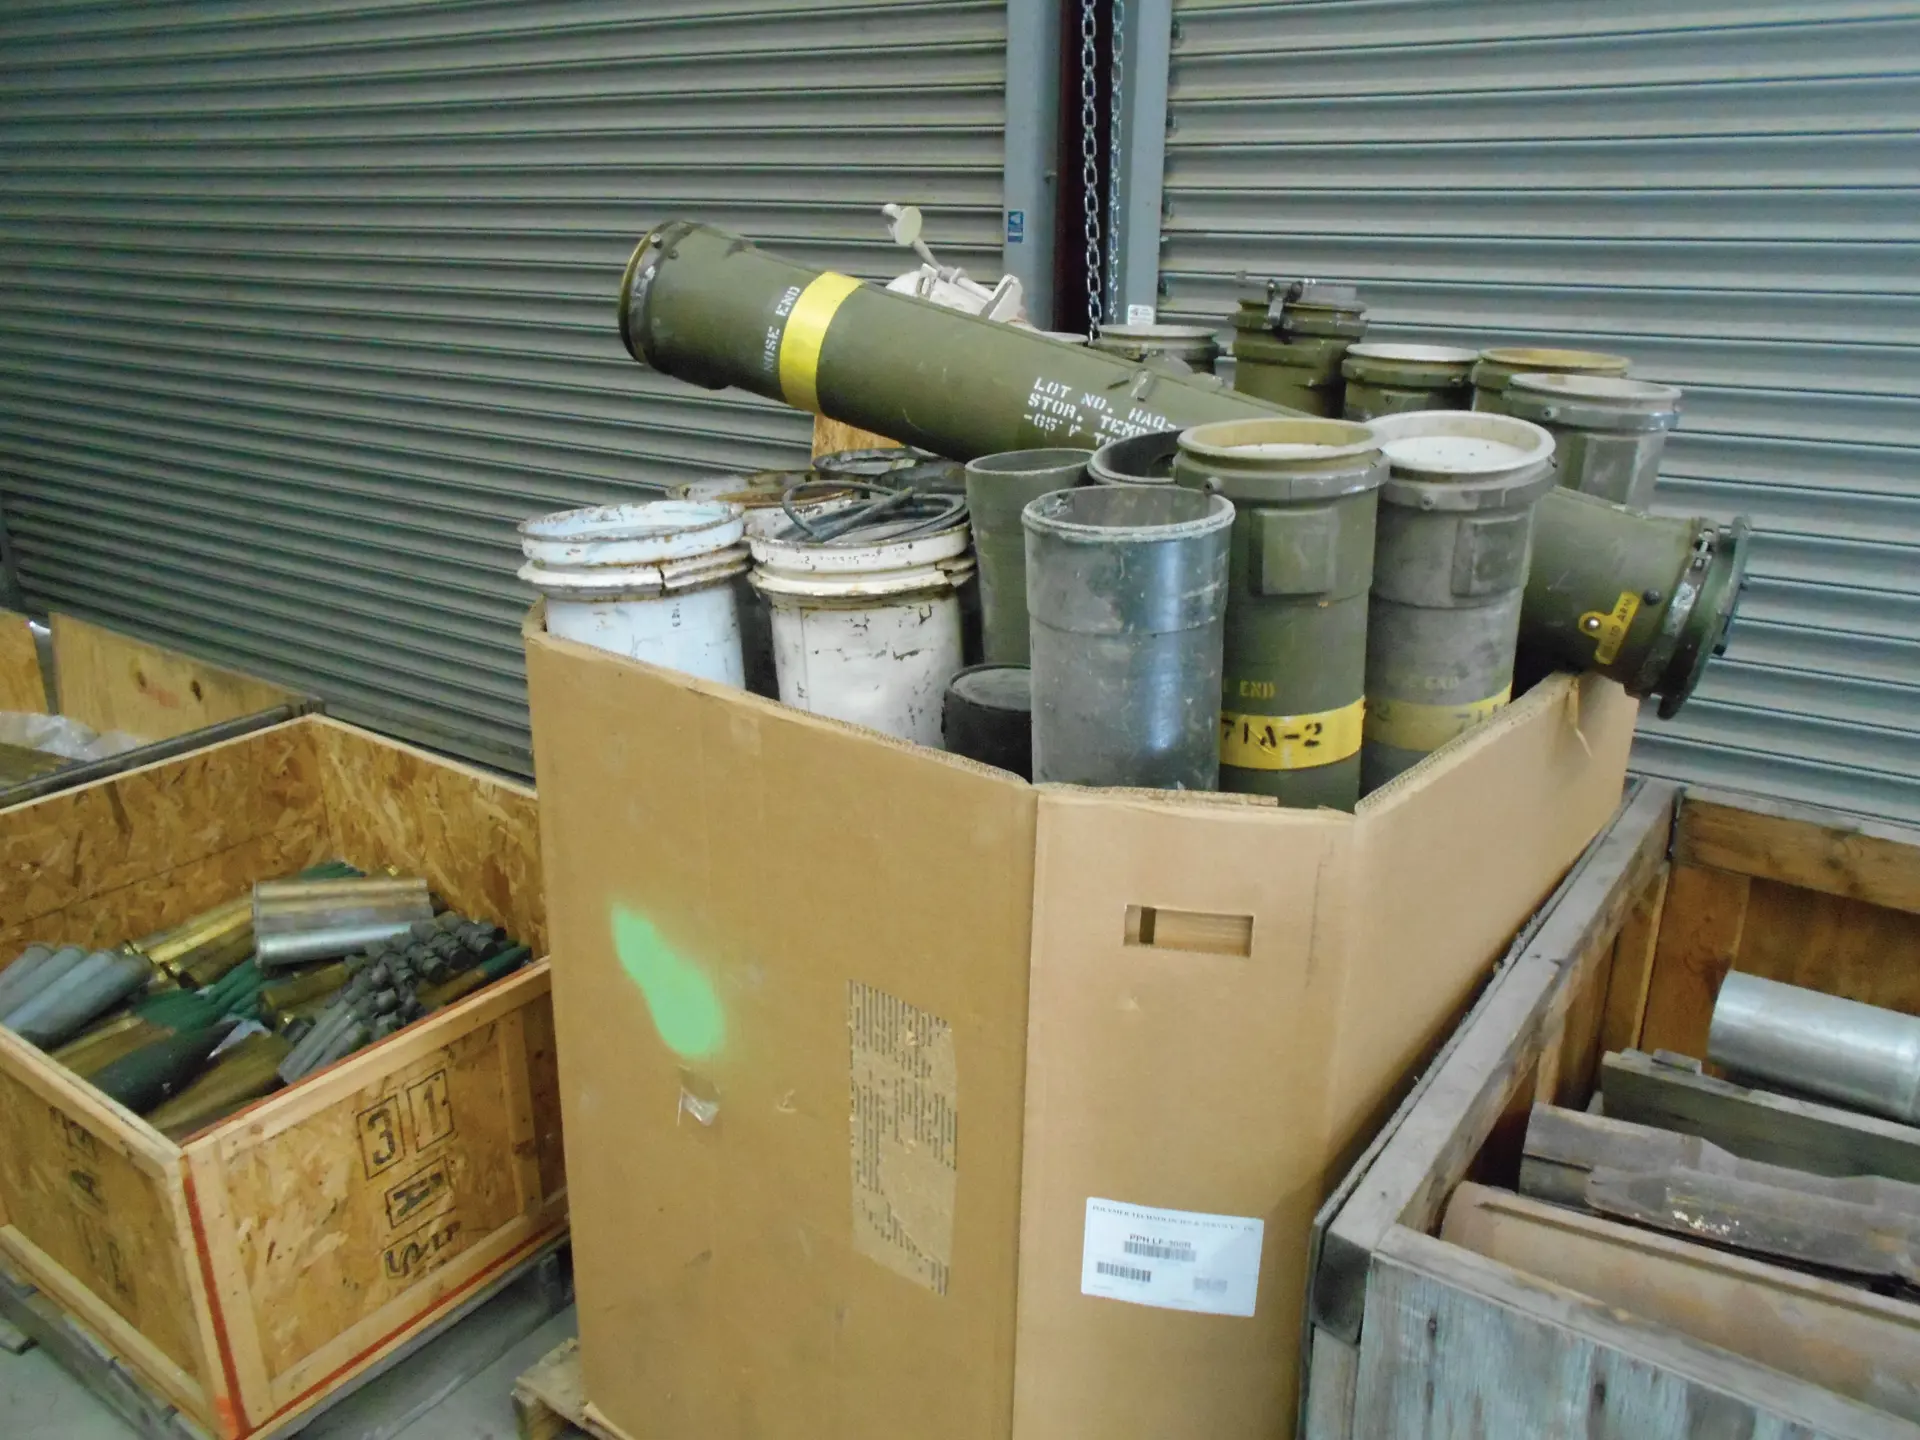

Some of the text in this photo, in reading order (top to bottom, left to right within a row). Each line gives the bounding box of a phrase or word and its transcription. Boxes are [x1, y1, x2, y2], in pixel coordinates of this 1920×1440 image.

[775, 286, 801, 317] END
[1033, 376, 1072, 399] LOT
[1080, 392, 1114, 414] NO.
[1239, 680, 1276, 699] END
